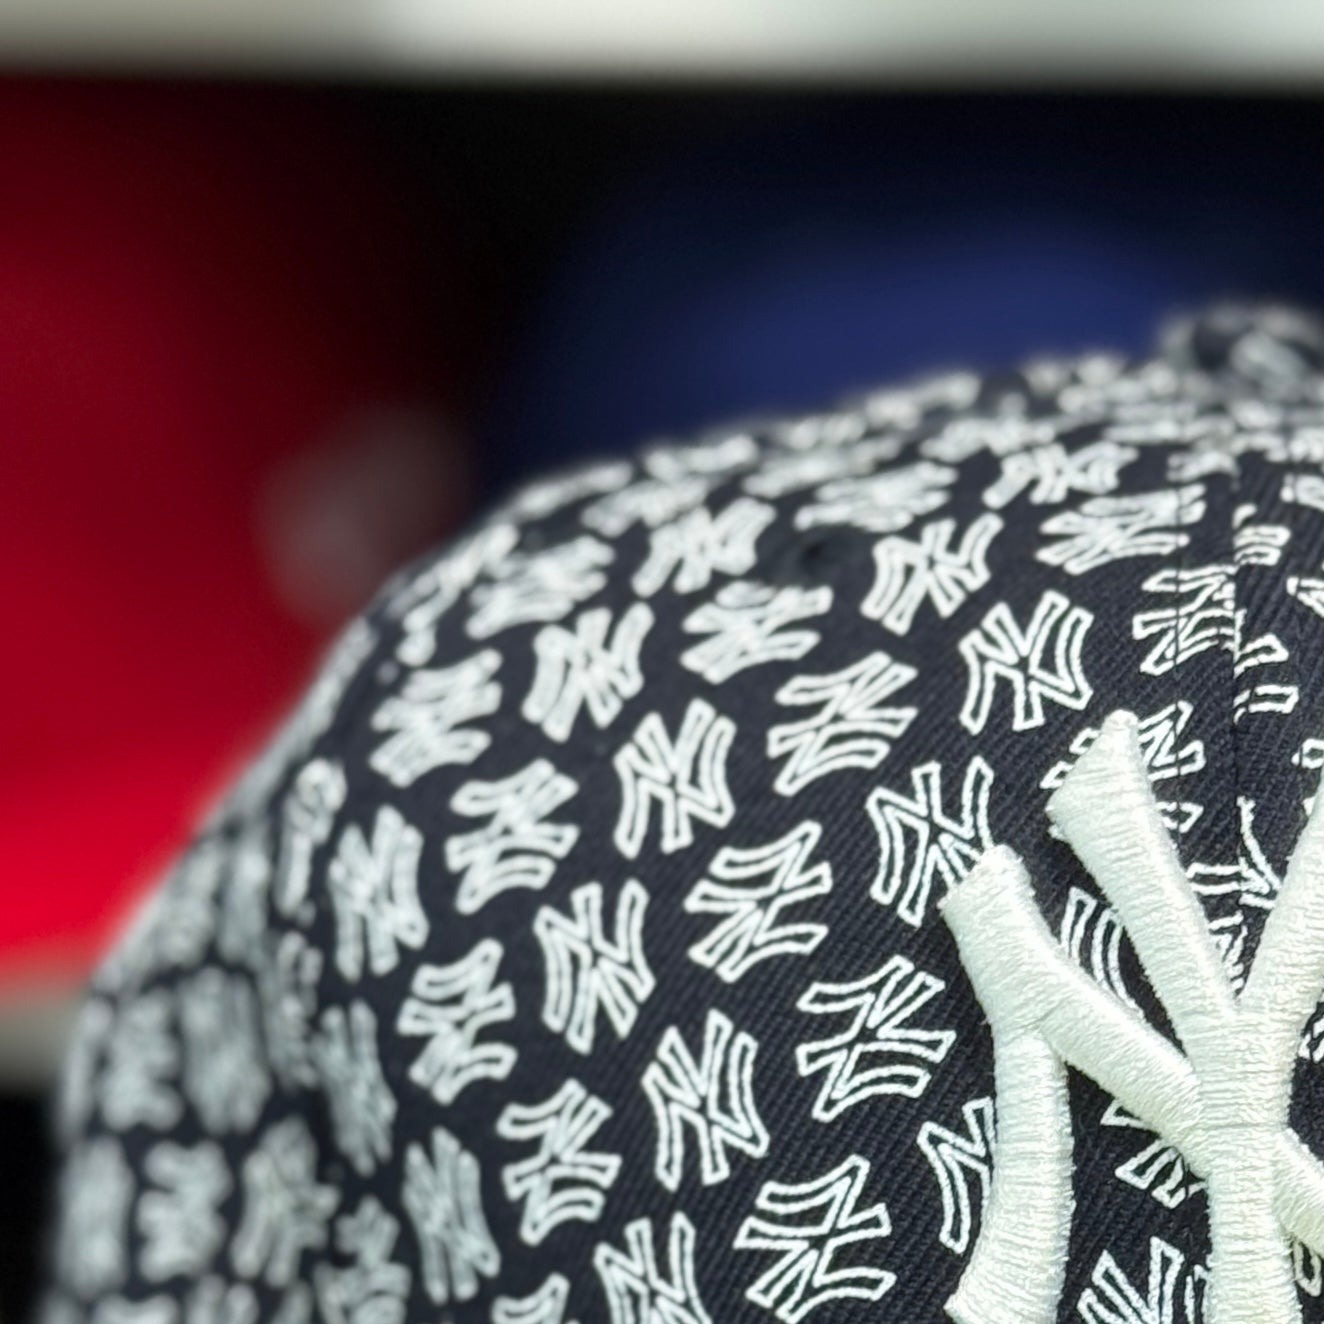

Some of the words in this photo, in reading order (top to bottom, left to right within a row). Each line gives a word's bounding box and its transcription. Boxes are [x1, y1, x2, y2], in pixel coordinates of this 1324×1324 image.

[861, 513, 1003, 635] NY
[767, 652, 918, 796] NY
[959, 590, 1094, 735] NY
[614, 699, 736, 858] NY
[534, 879, 655, 1053] NY
[684, 820, 833, 983] NY
[397, 939, 517, 1104] NY
[641, 1009, 770, 1191] NY
[795, 955, 956, 1122] NY
[497, 1079, 622, 1245] NY
